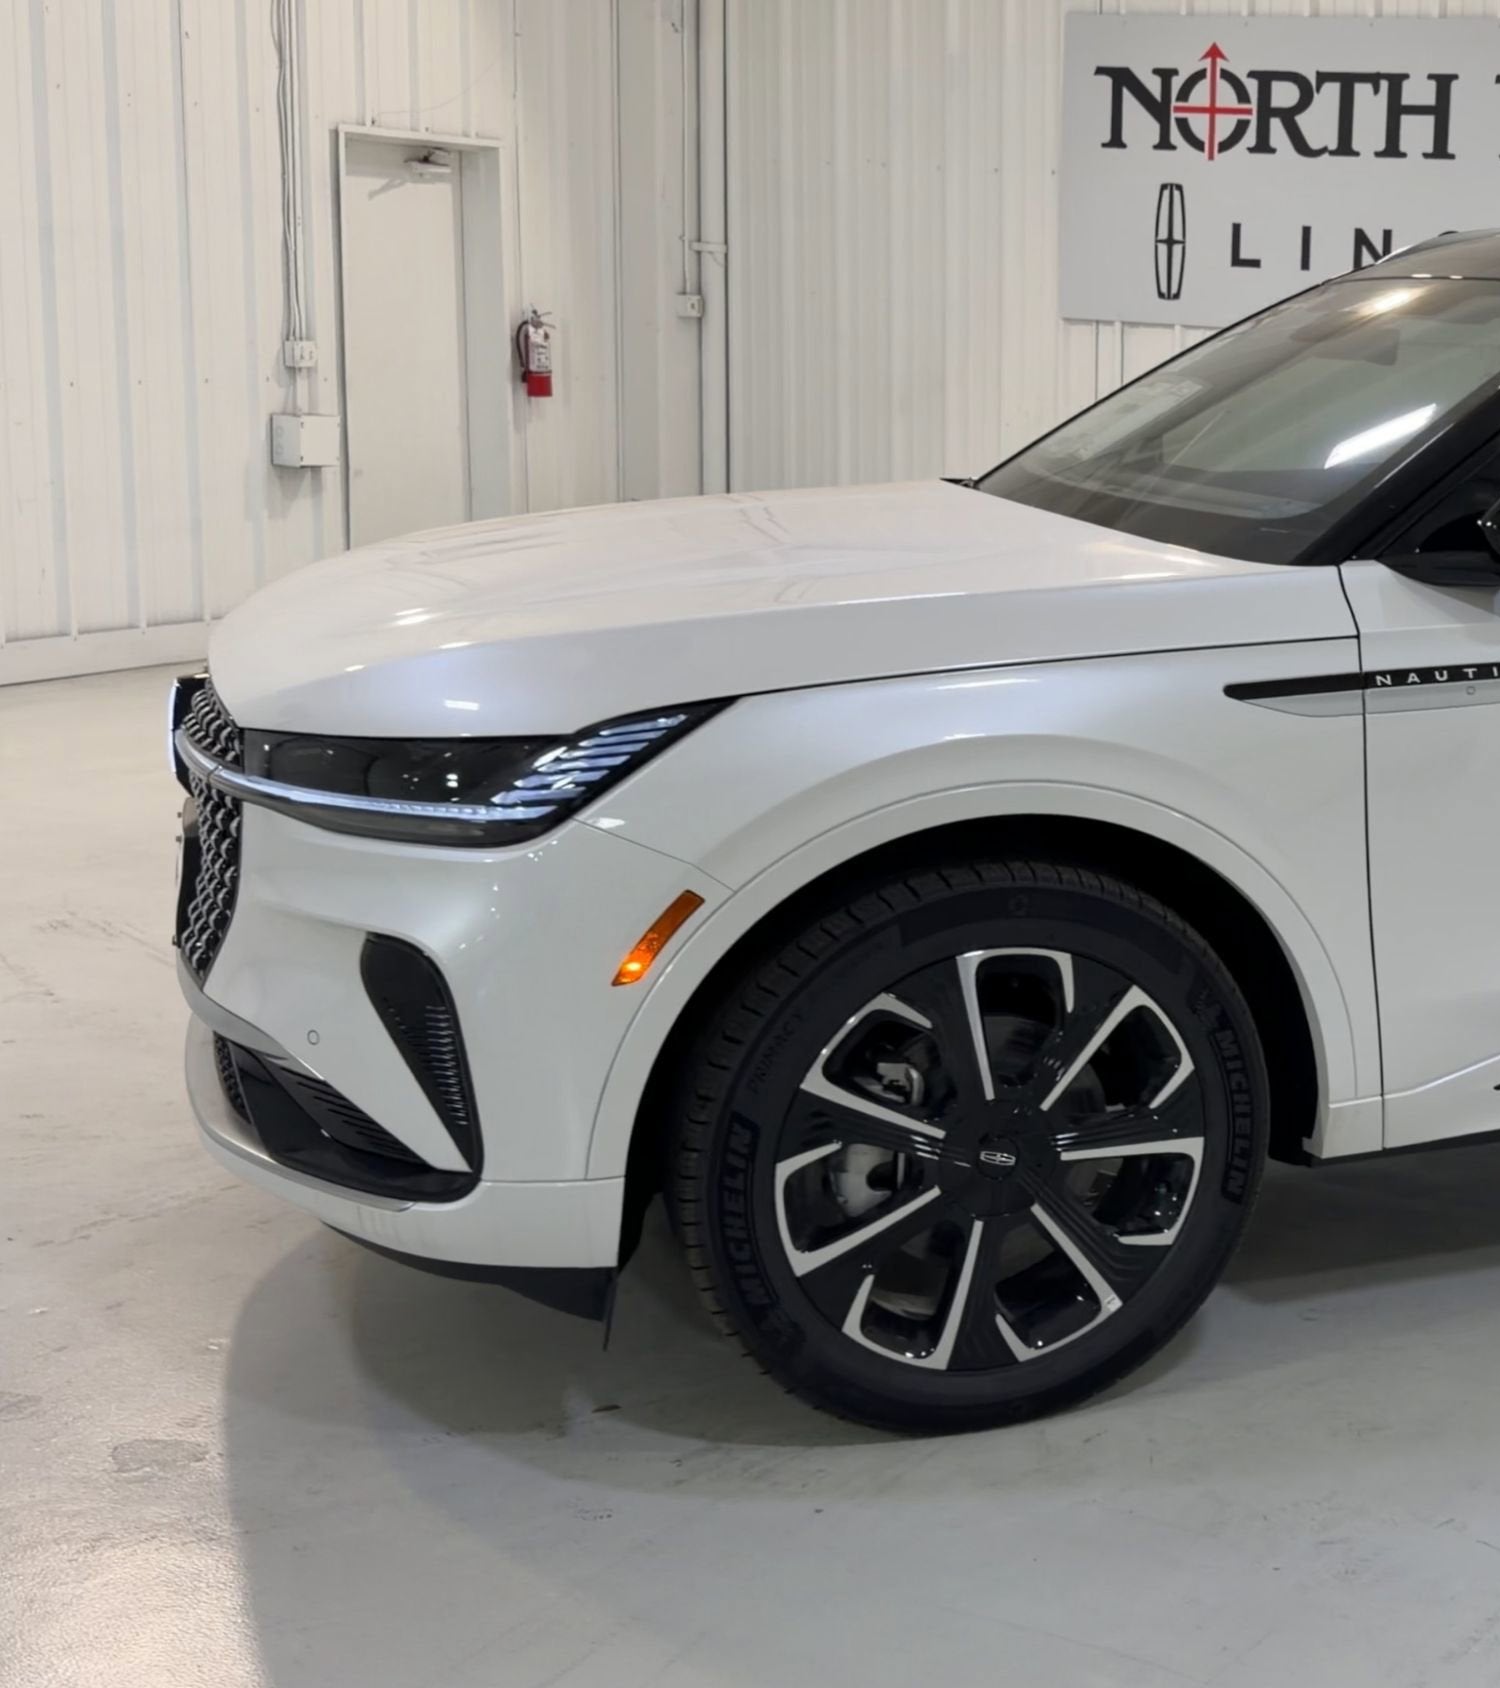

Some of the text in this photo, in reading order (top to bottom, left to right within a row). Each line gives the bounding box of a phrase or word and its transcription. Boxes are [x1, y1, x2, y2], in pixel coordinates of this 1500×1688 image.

[1094, 66, 1459, 161] NORTH
[1214, 1027, 1252, 1199] MICHELIN
[721, 1118, 771, 1306] MICHELIN
